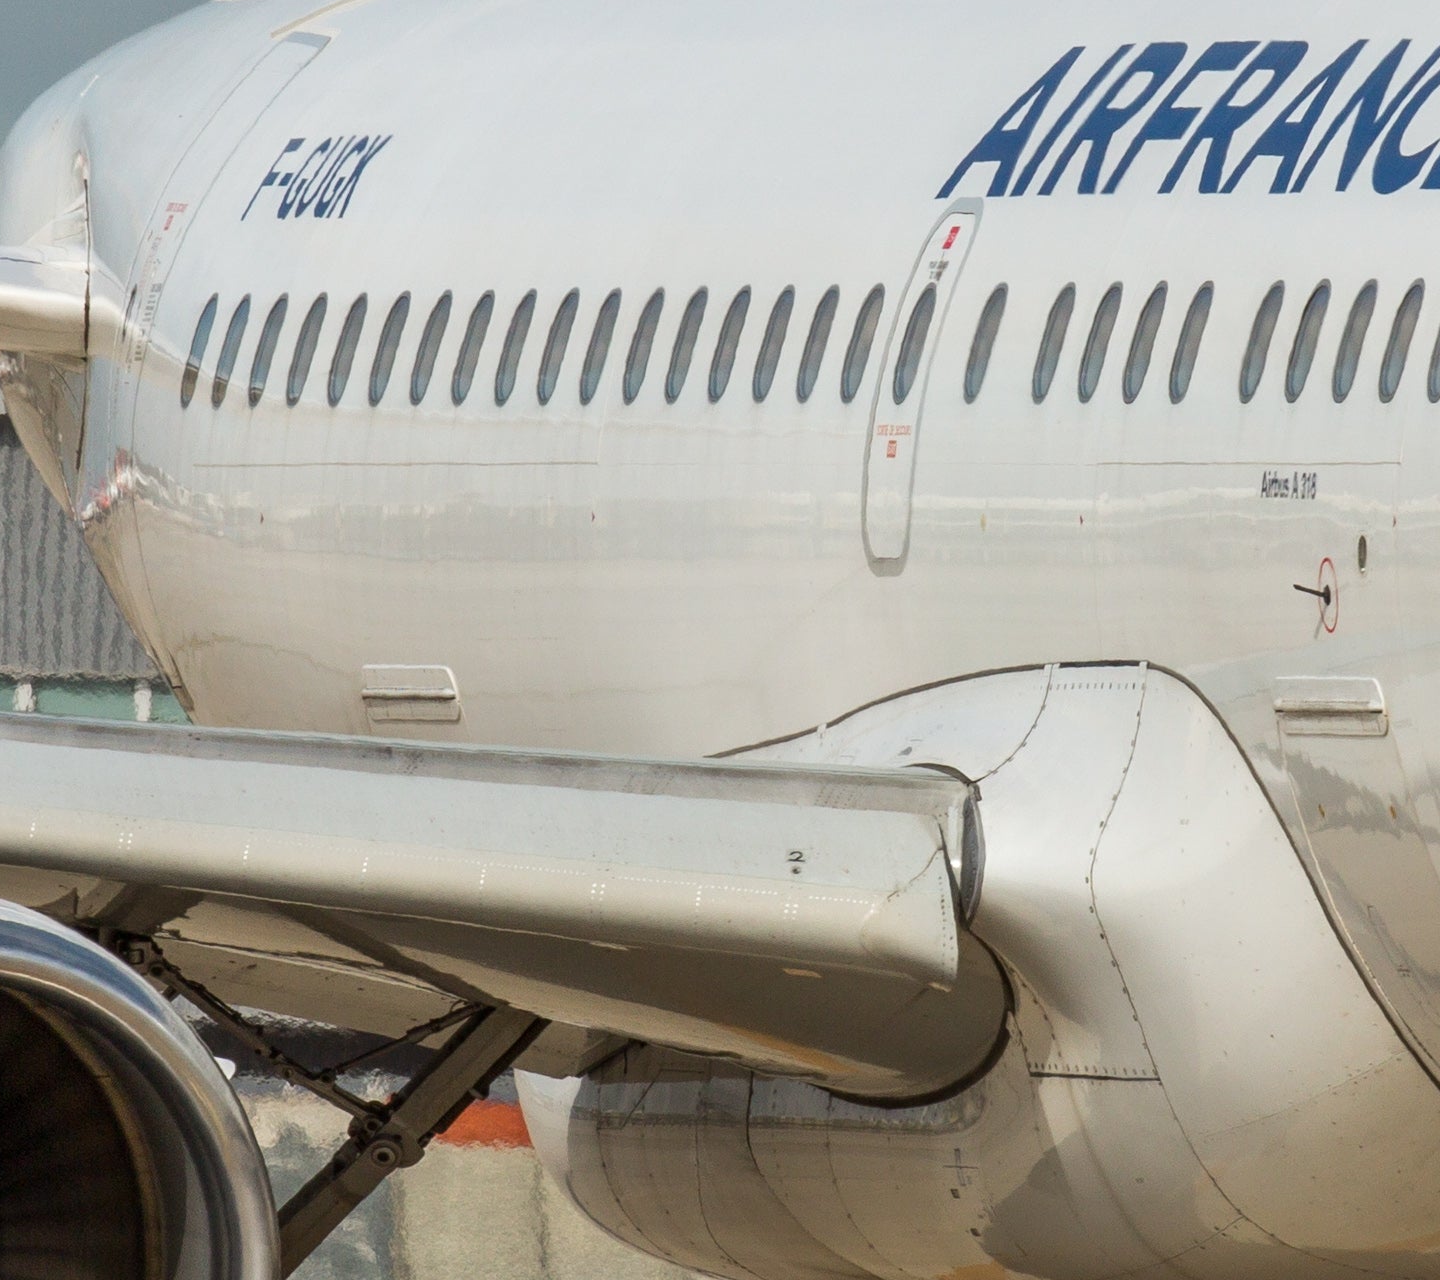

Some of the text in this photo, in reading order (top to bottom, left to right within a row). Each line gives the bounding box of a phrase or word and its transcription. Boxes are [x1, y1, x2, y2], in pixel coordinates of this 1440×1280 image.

[241, 134, 393, 222] F-GUGK
[1260, 470, 1317, 500] Airbus A 318
[787, 851, 806, 862] 2
